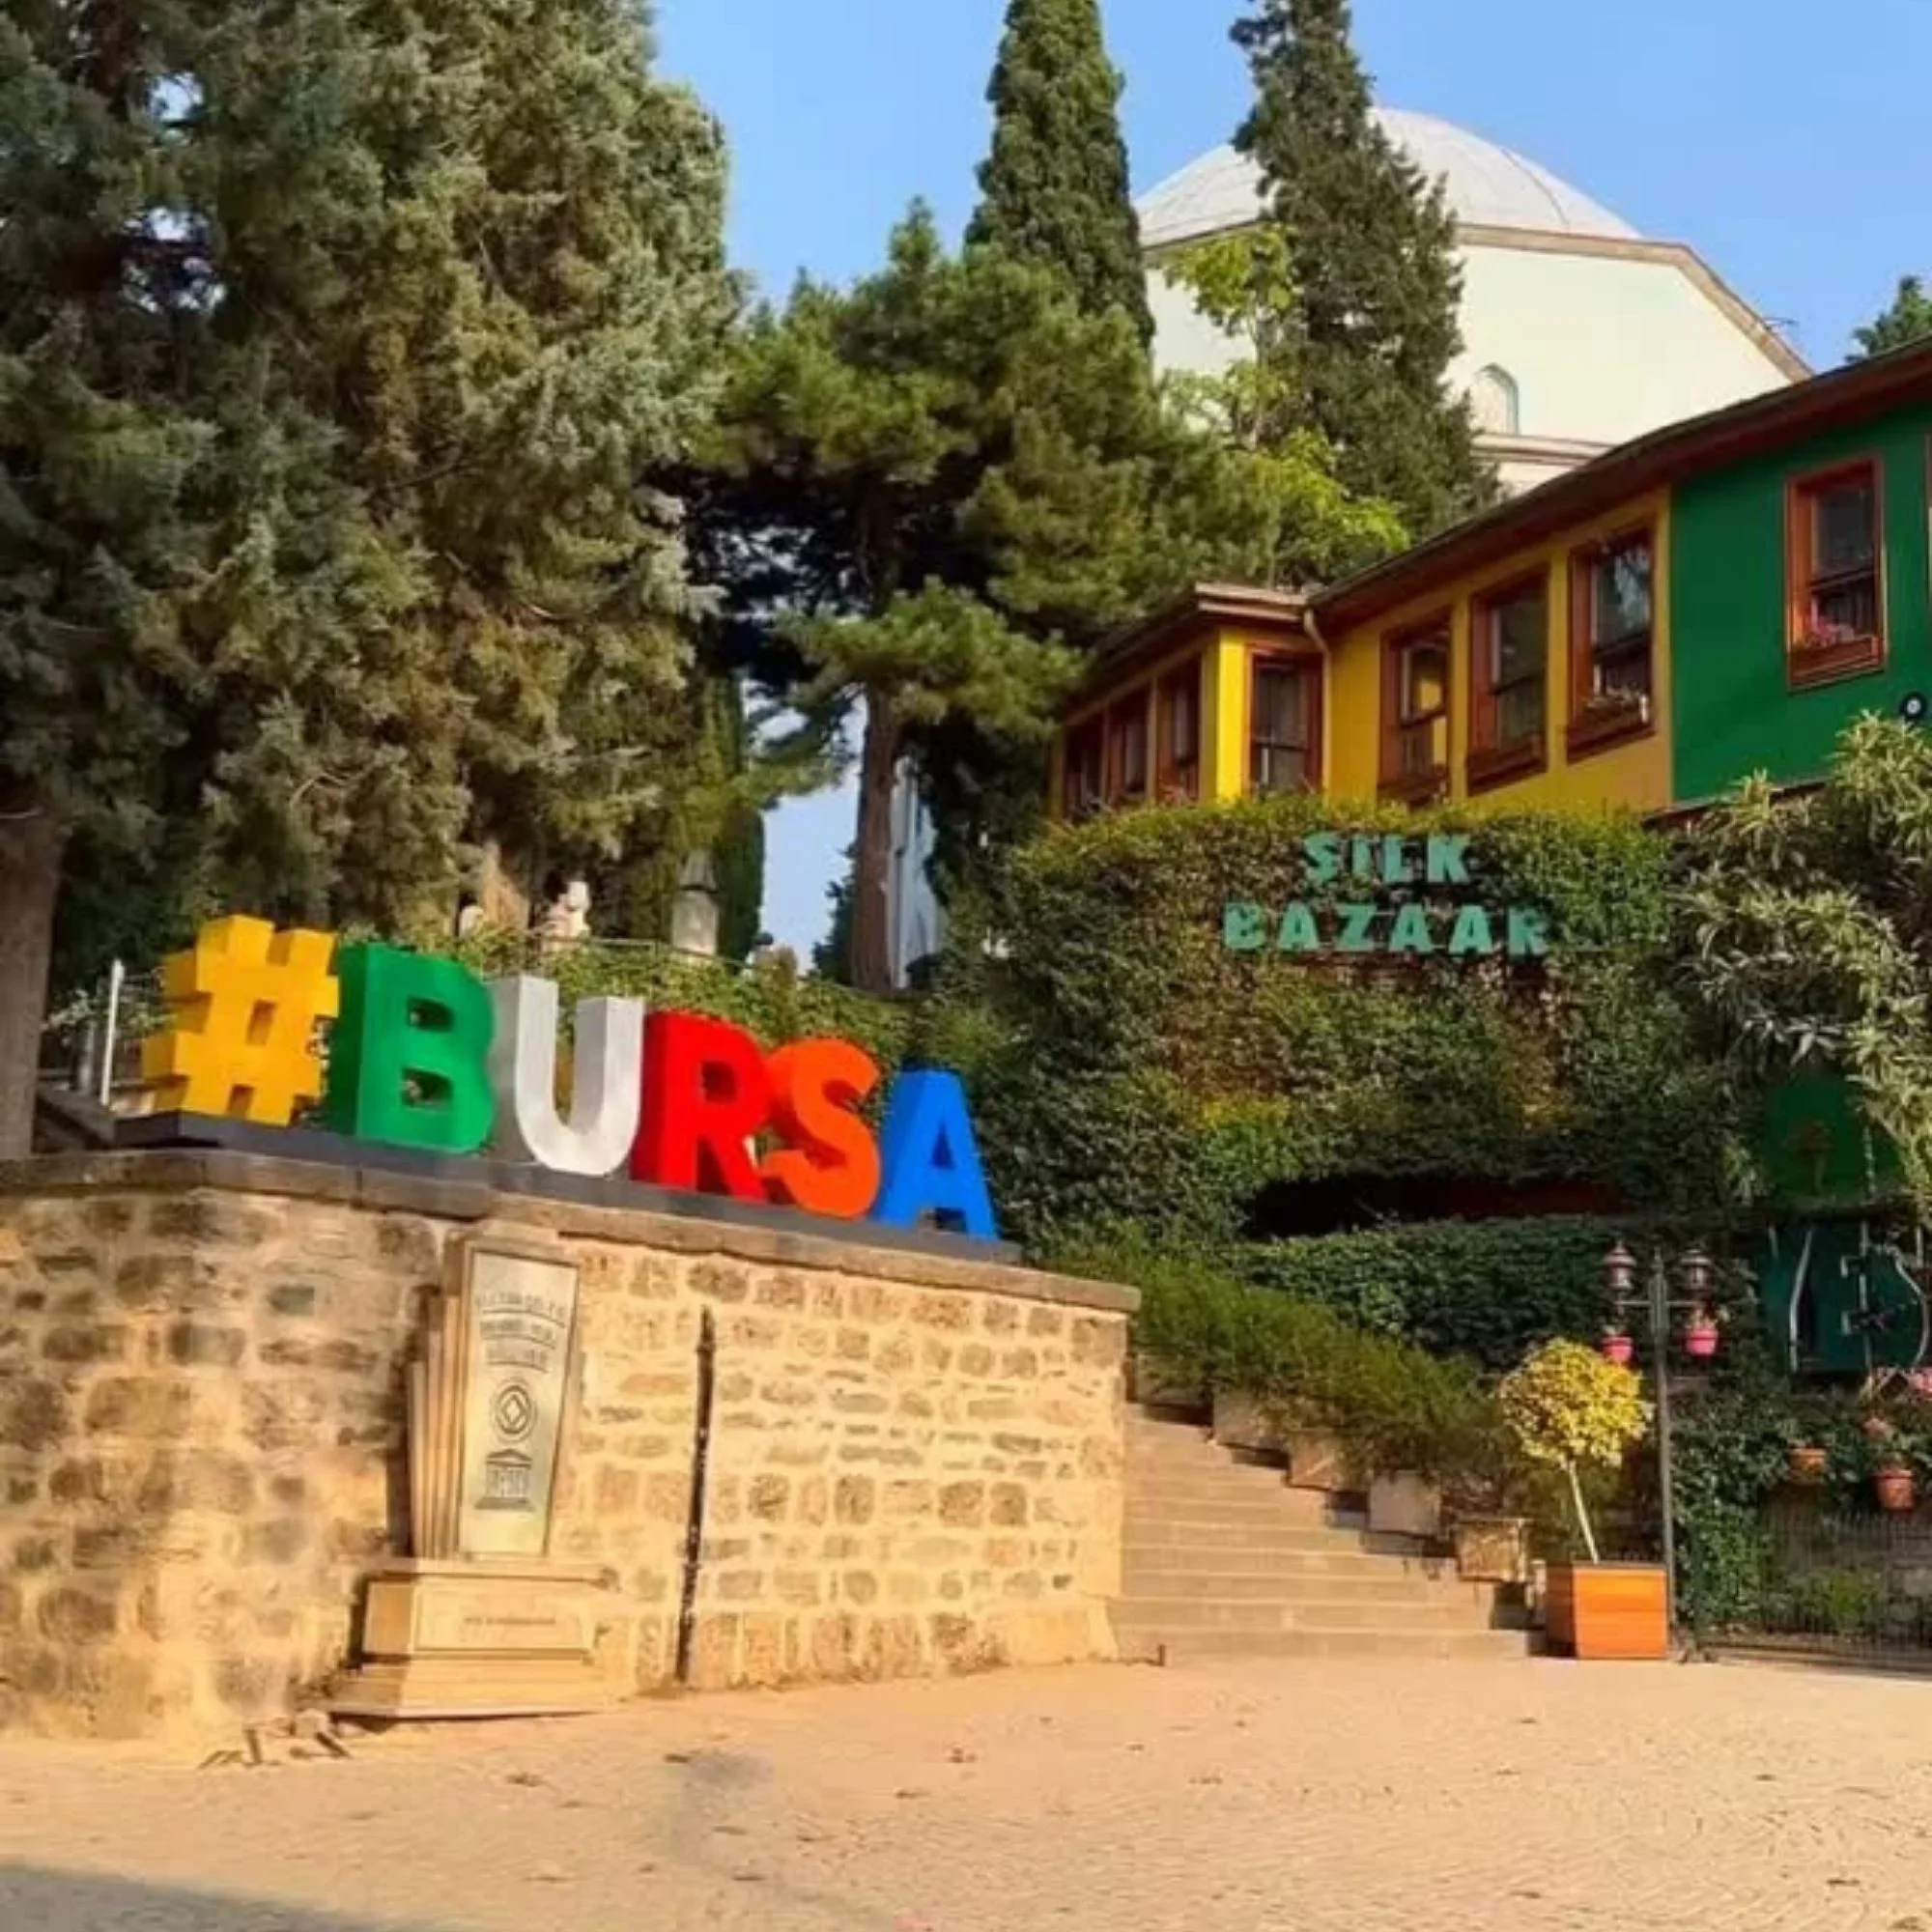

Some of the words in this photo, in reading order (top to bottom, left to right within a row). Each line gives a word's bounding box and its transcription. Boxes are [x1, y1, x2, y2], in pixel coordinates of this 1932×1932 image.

[1303, 832, 1471, 883] SILK
[1224, 902, 1548, 955] BAZAAR
[142, 914, 998, 1239] #BURSA
